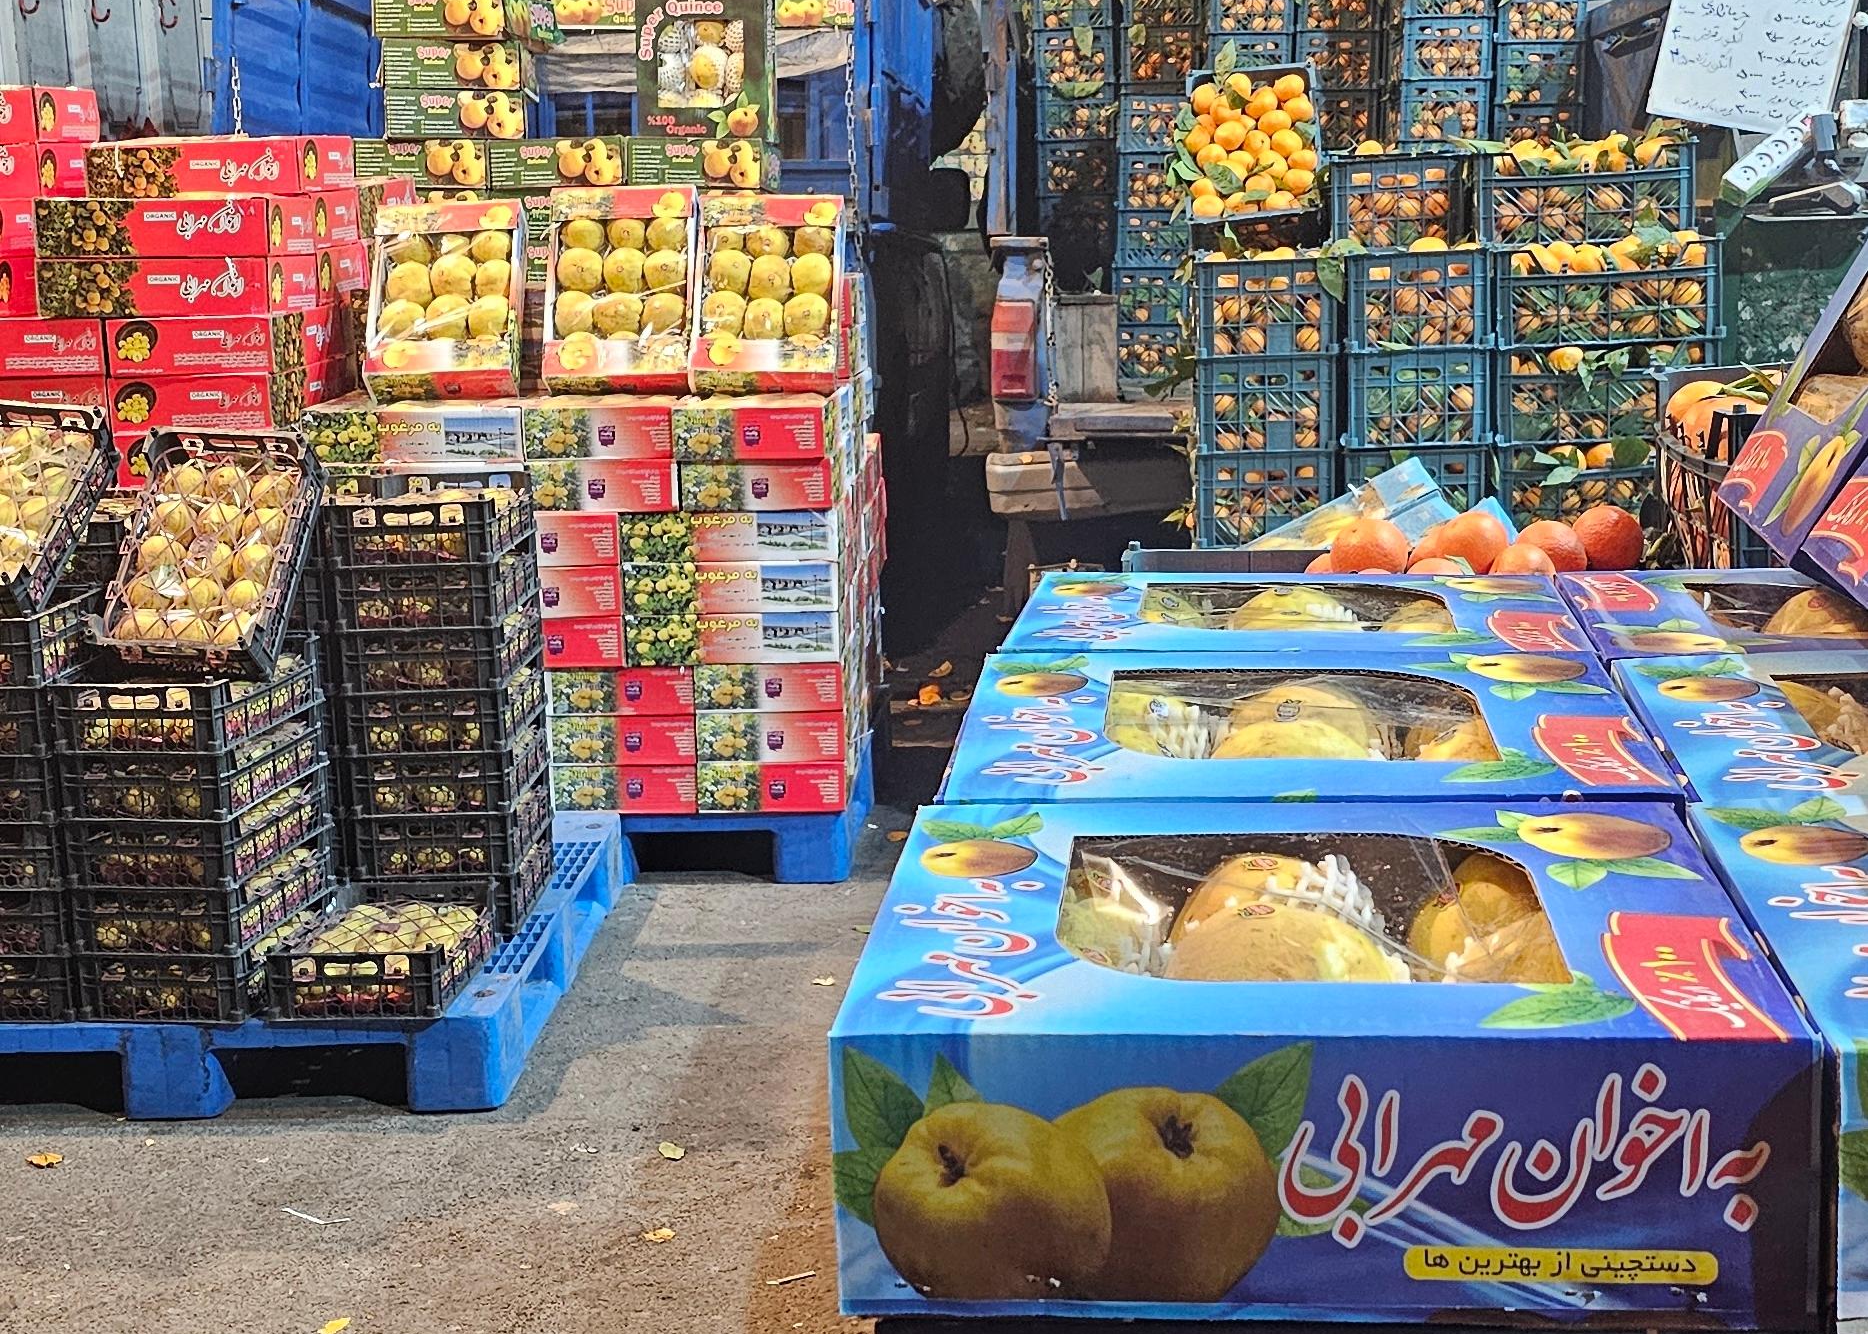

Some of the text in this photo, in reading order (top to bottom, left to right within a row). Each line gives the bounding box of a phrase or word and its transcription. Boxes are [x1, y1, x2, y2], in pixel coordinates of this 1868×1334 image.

[638, 6, 665, 61] Super
[416, 45, 452, 60] Super
[420, 94, 456, 109] Super
[666, 123, 708, 136] Organic
[519, 146, 554, 159] Super
[665, 143, 700, 157] Super
[524, 195, 551, 209] Supe
[527, 246, 548, 259] Sup
[148, 276, 179, 284] ORGANIC
[193, 331, 223, 339] ORGANIC
[191, 392, 221, 400] ORGANIC
[376, 419, 424, 436] مرغوب
[690, 513, 736, 528] مرغوب
[694, 568, 740, 583] مرغوب
[695, 616, 742, 632] مرغوب
[875, 951, 1047, 1020] مهرابی
[1278, 1062, 1771, 1250] به اخوان مهرابی
[1423, 1248, 1698, 1281] دستچینی از بهترین ها
